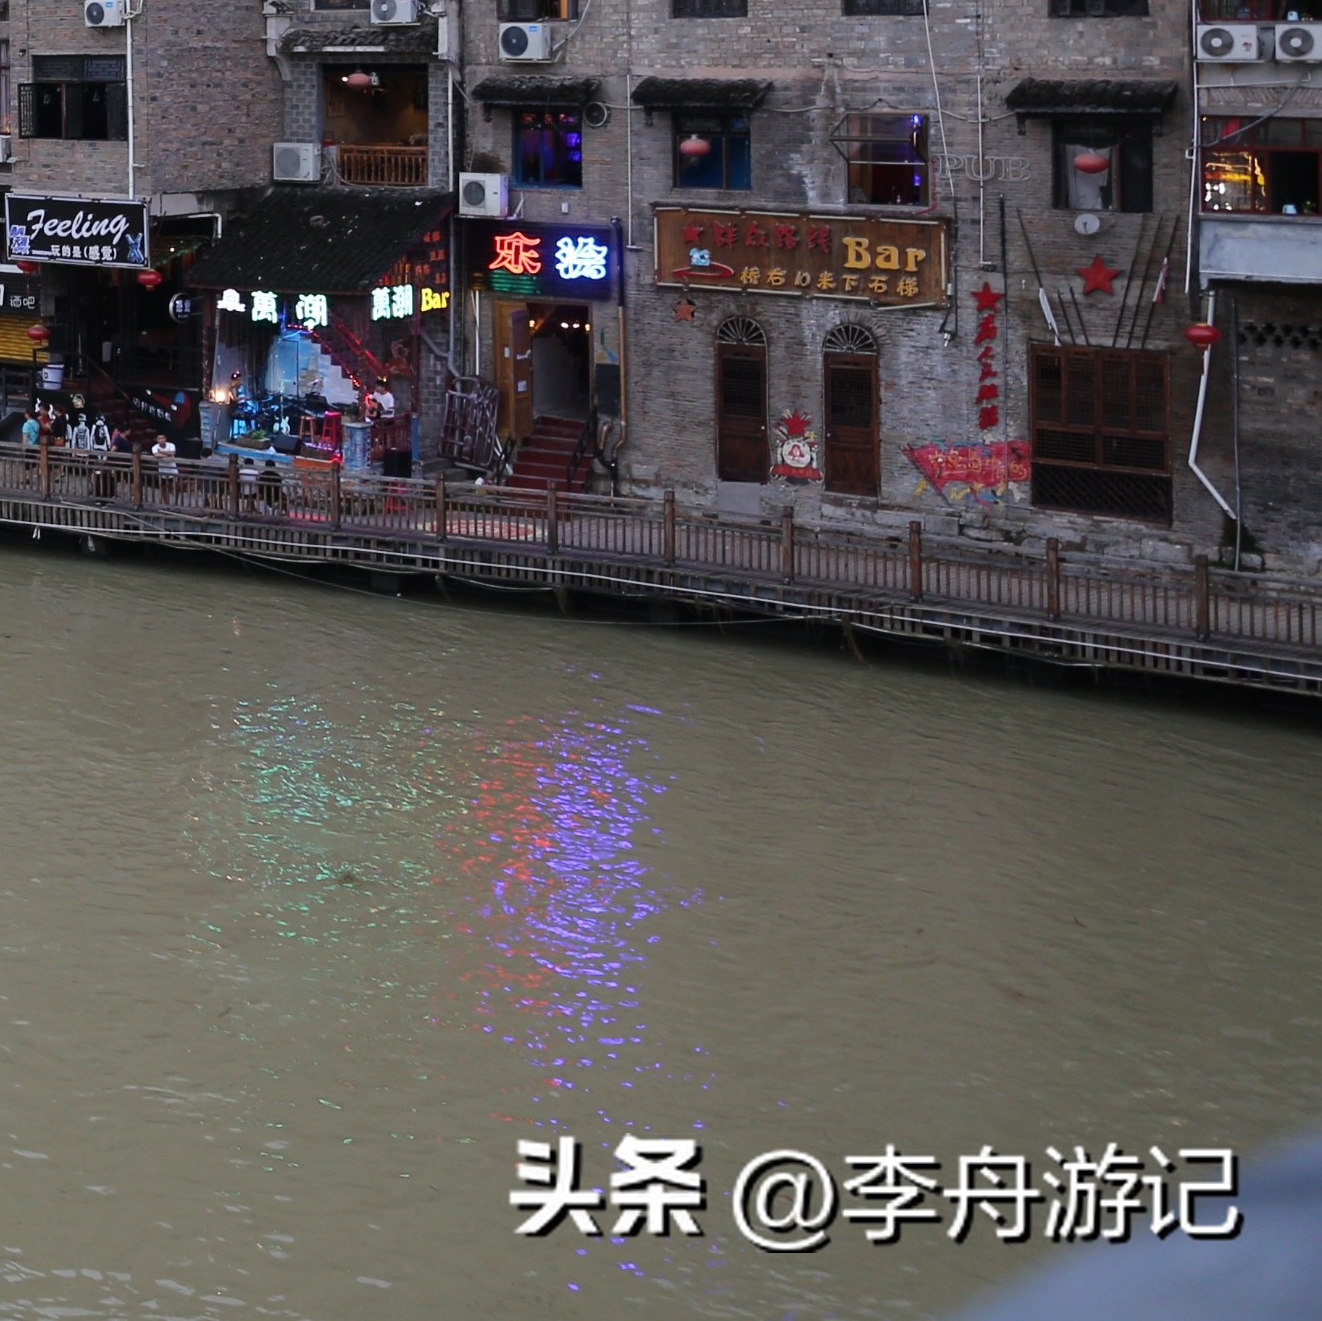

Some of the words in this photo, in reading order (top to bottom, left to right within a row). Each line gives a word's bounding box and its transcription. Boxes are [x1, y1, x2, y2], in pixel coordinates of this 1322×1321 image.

[937, 153, 1031, 181] PUB
[26, 209, 129, 245] Feeling
[842, 236, 926, 272] Bar
[9, 294, 35, 309] 酒吧
[421, 287, 450, 312] Bar
